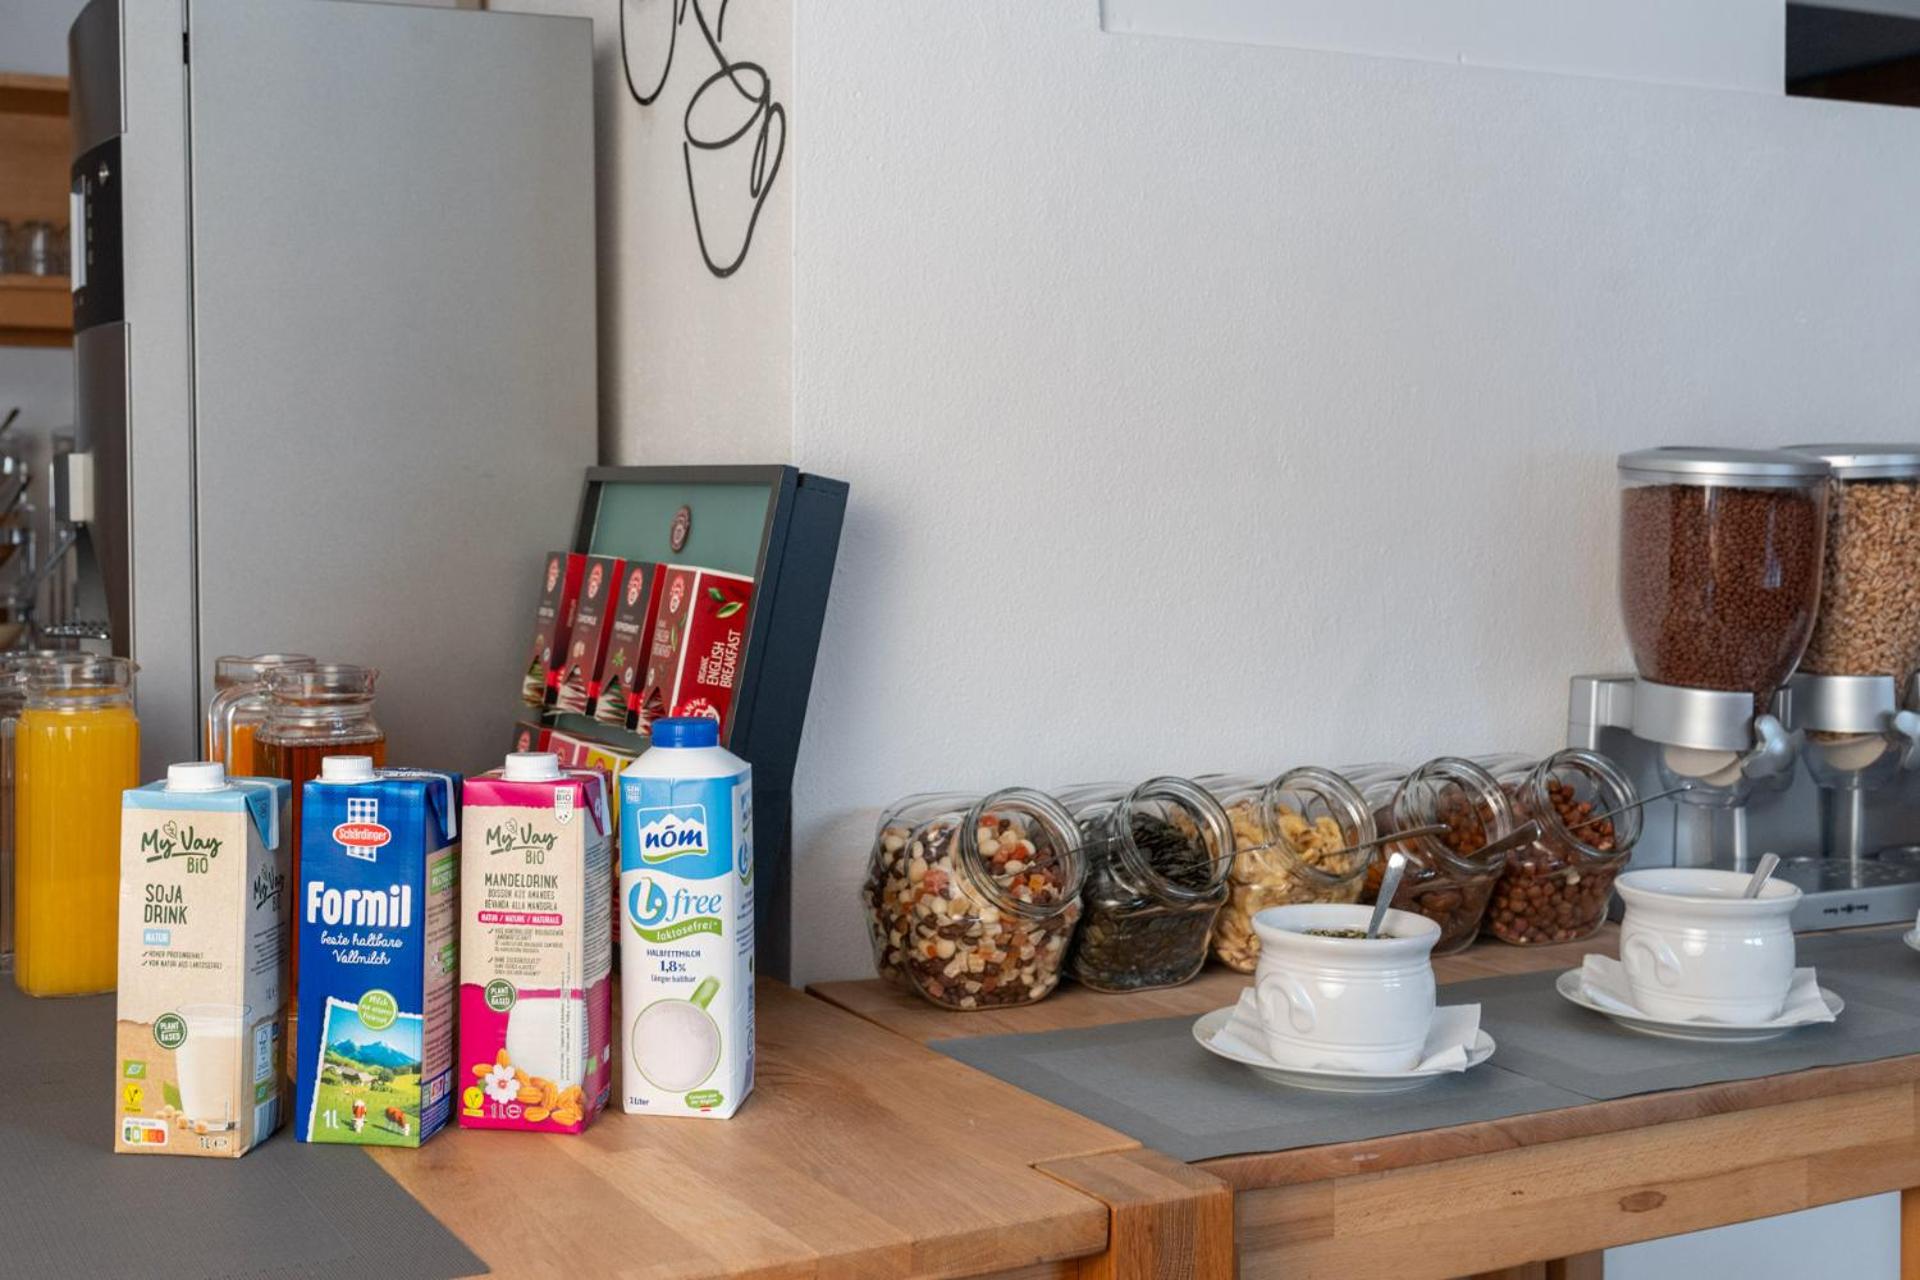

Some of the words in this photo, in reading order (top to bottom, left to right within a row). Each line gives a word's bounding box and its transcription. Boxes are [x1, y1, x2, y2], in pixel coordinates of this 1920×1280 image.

[706, 641, 725, 686] ENGLISH
[719, 629, 741, 689] BREAKFAST
[141, 828, 177, 859] My
[180, 825, 223, 858] Vay
[486, 826, 516, 851] My
[520, 823, 558, 850] Vay
[485, 873, 558, 889] MANDELDRINK
[145, 883, 183, 904] SOJA
[307, 881, 411, 927] Formil
[144, 904, 187, 925] DRINK
[666, 888, 722, 921] free
[321, 930, 349, 945] beste
[352, 932, 403, 948] haltbare
[332, 949, 390, 965] Vollmilch
[647, 949, 701, 957] HALBFETTMILCH
[160, 1022, 179, 1031] PLANT
